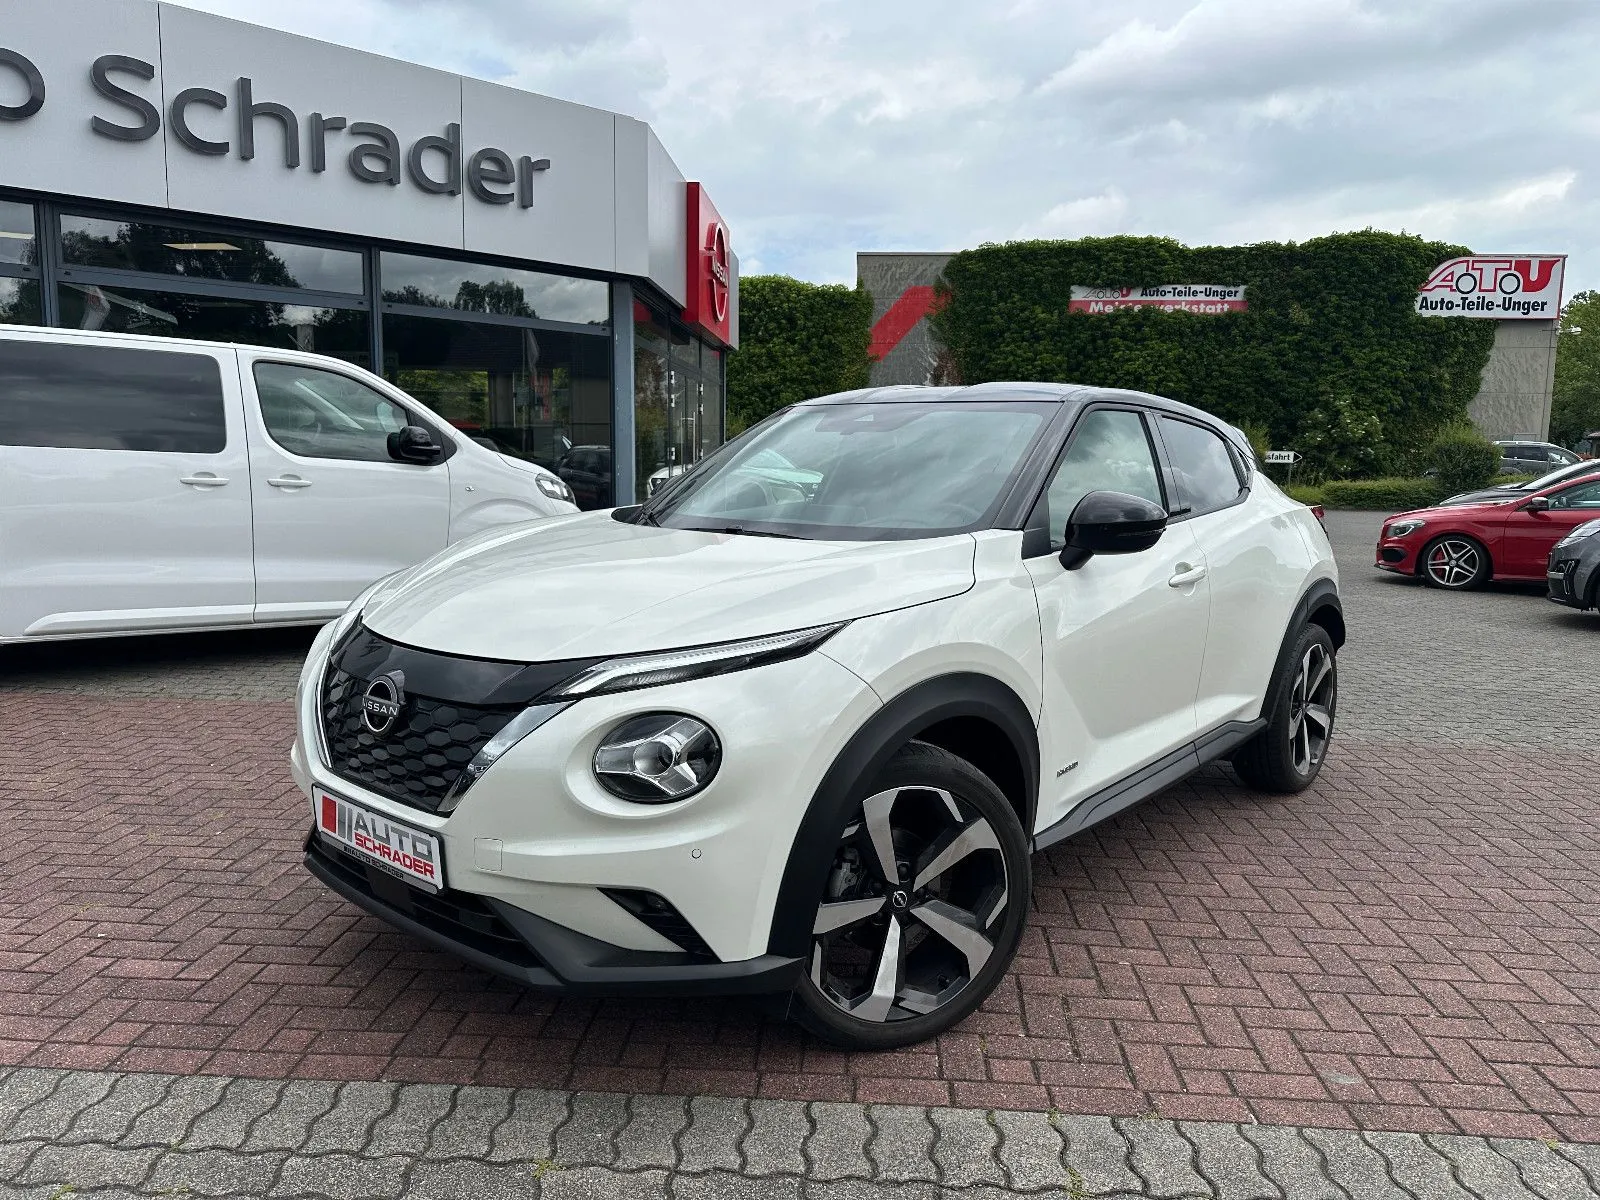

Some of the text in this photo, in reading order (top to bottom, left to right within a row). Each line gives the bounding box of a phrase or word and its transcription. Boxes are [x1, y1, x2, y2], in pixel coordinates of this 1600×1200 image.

[91, 54, 550, 209] Schrader
[1140, 286, 1239, 300] Auto-Teile-Unger
[1418, 296, 1548, 316] Auto-Teile-Unger
[353, 811, 434, 863] AUTO
[354, 831, 435, 880] SCHRADER
